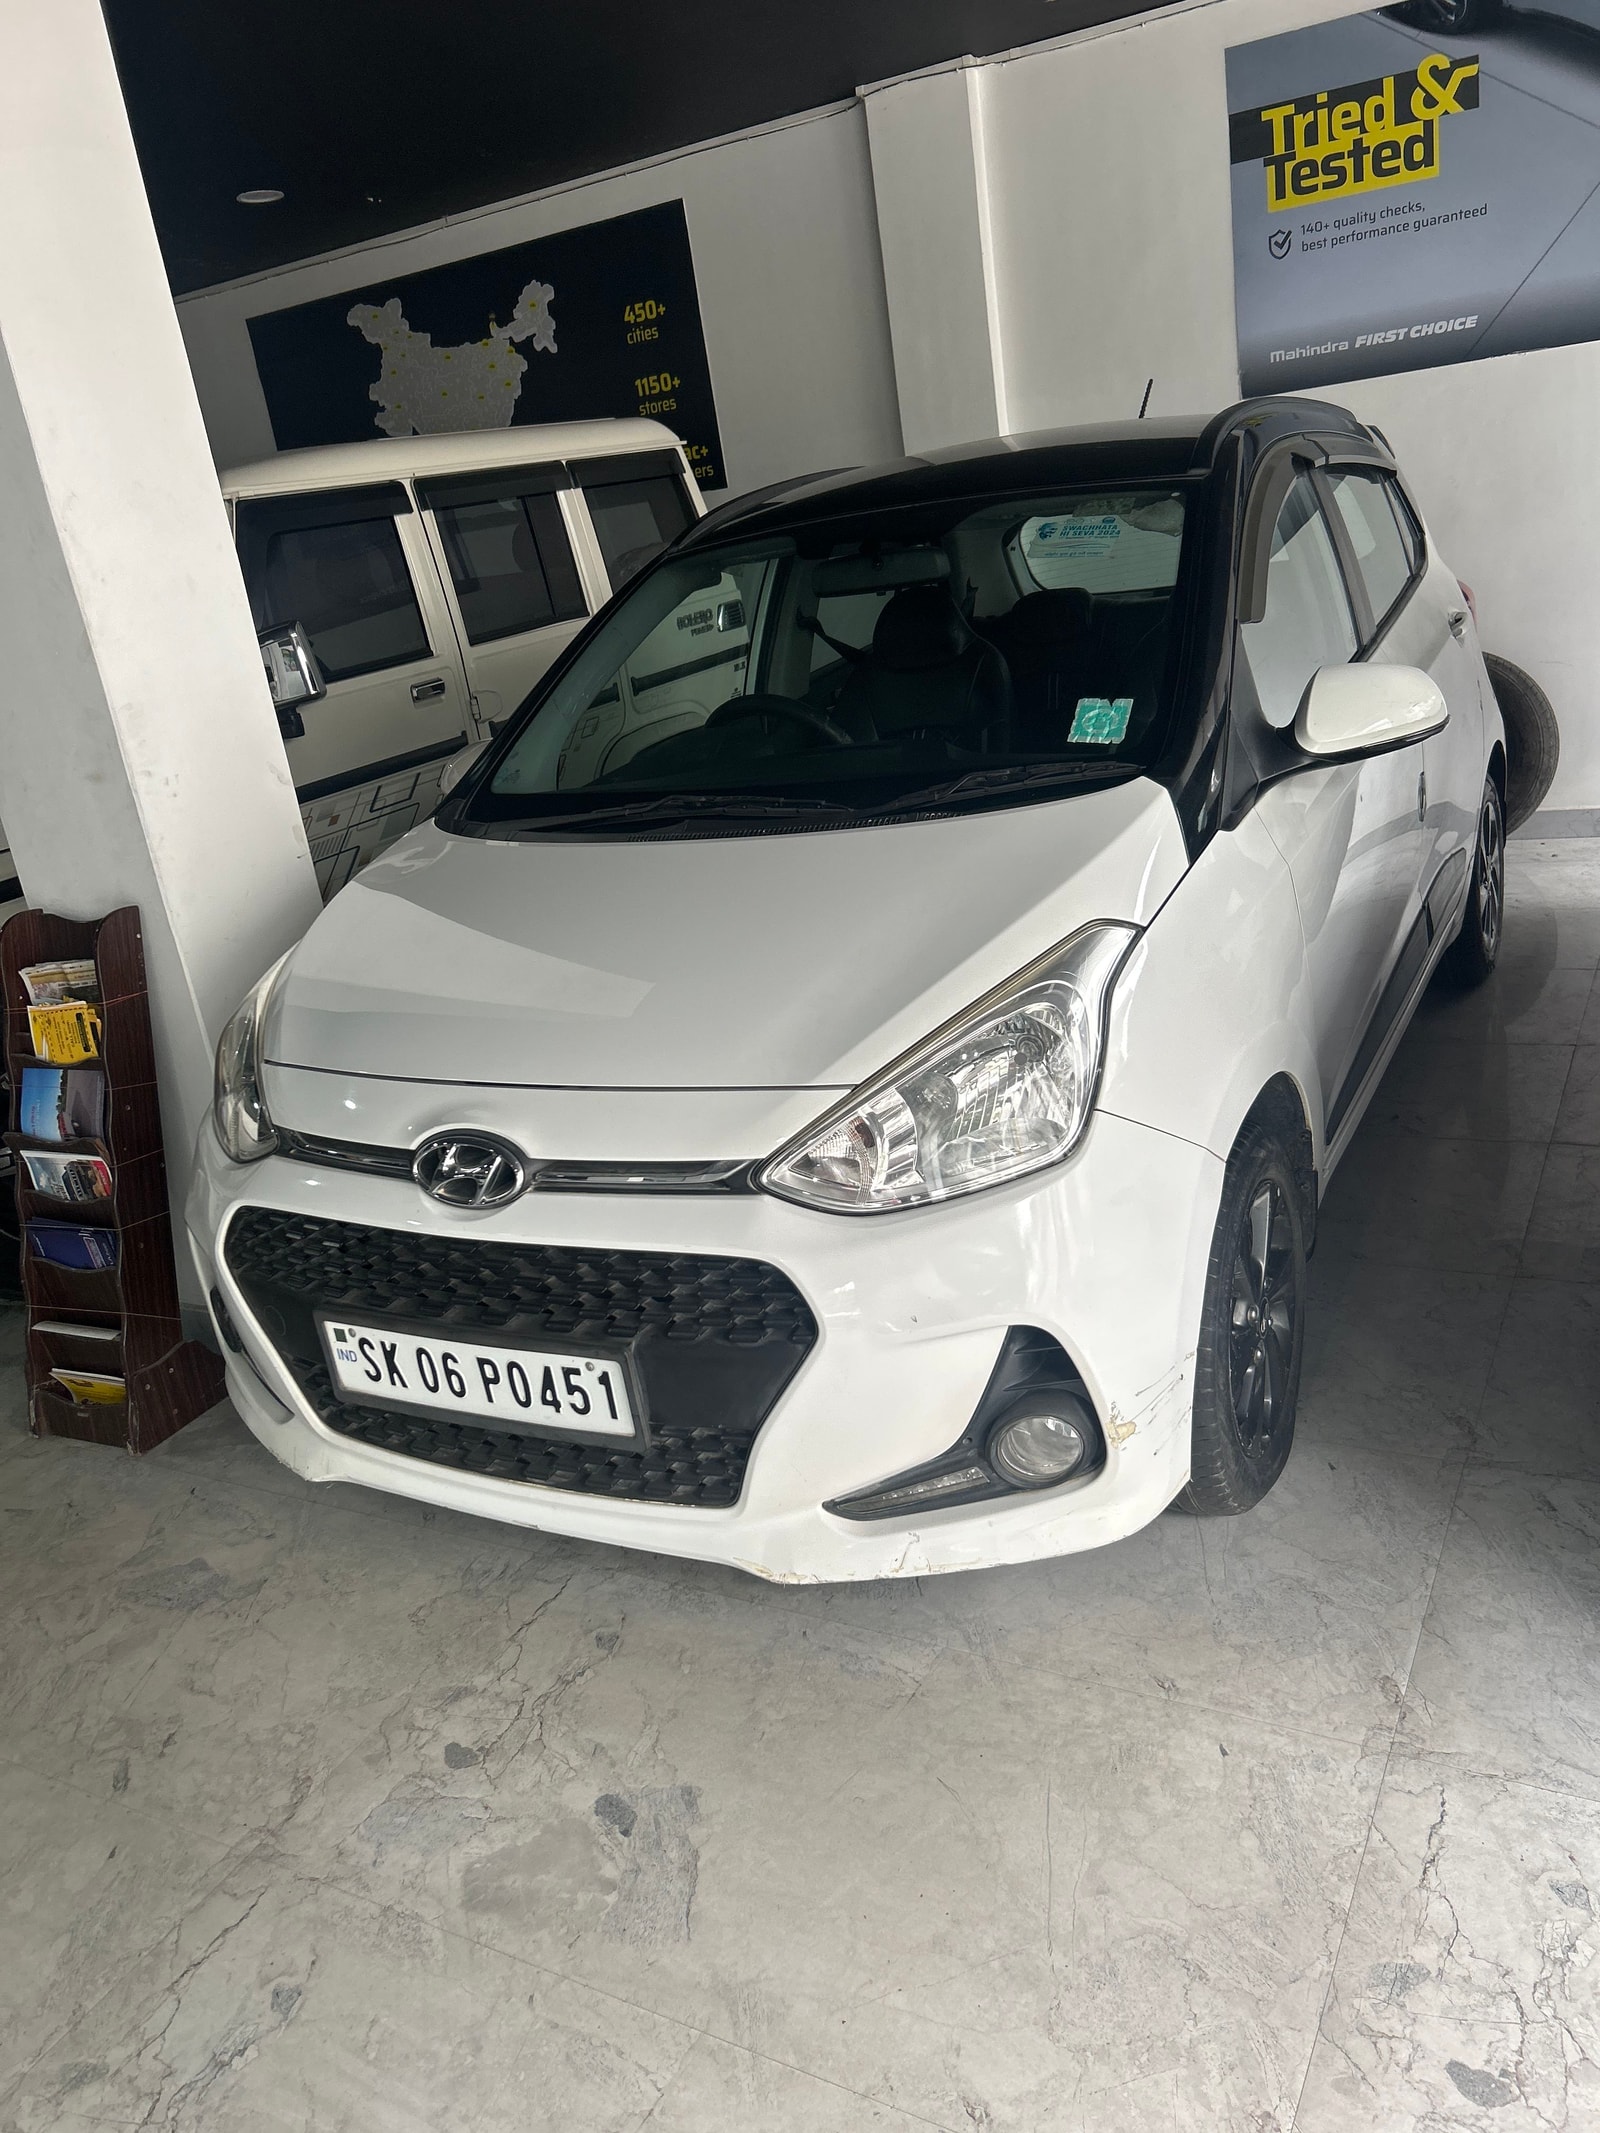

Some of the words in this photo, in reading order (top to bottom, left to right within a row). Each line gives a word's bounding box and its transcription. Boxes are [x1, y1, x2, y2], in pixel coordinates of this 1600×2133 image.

[1261, 76, 1395, 156] Tried
[1411, 54, 1479, 121] &
[1263, 120, 1435, 202] Tested
[1300, 220, 1330, 236] 140+
[1333, 210, 1376, 230] quality
[1380, 201, 1426, 219] checks,
[1301, 237, 1328, 252] best
[1331, 222, 1410, 248] performance
[1413, 203, 1488, 232] guaranteed
[623, 299, 666, 324] 450+
[626, 326, 659, 345] cities
[1270, 340, 1349, 363] Mahindra
[1355, 328, 1409, 349] FIRST
[1410, 315, 1479, 338] CHOICE
[634, 372, 681, 397] 1150+
[639, 398, 677, 416] stores
[336, 1348, 357, 1363] IND
[358, 1337, 408, 1388] SK
[415, 1347, 466, 1399] 06
[476, 1356, 619, 1420] P0451
